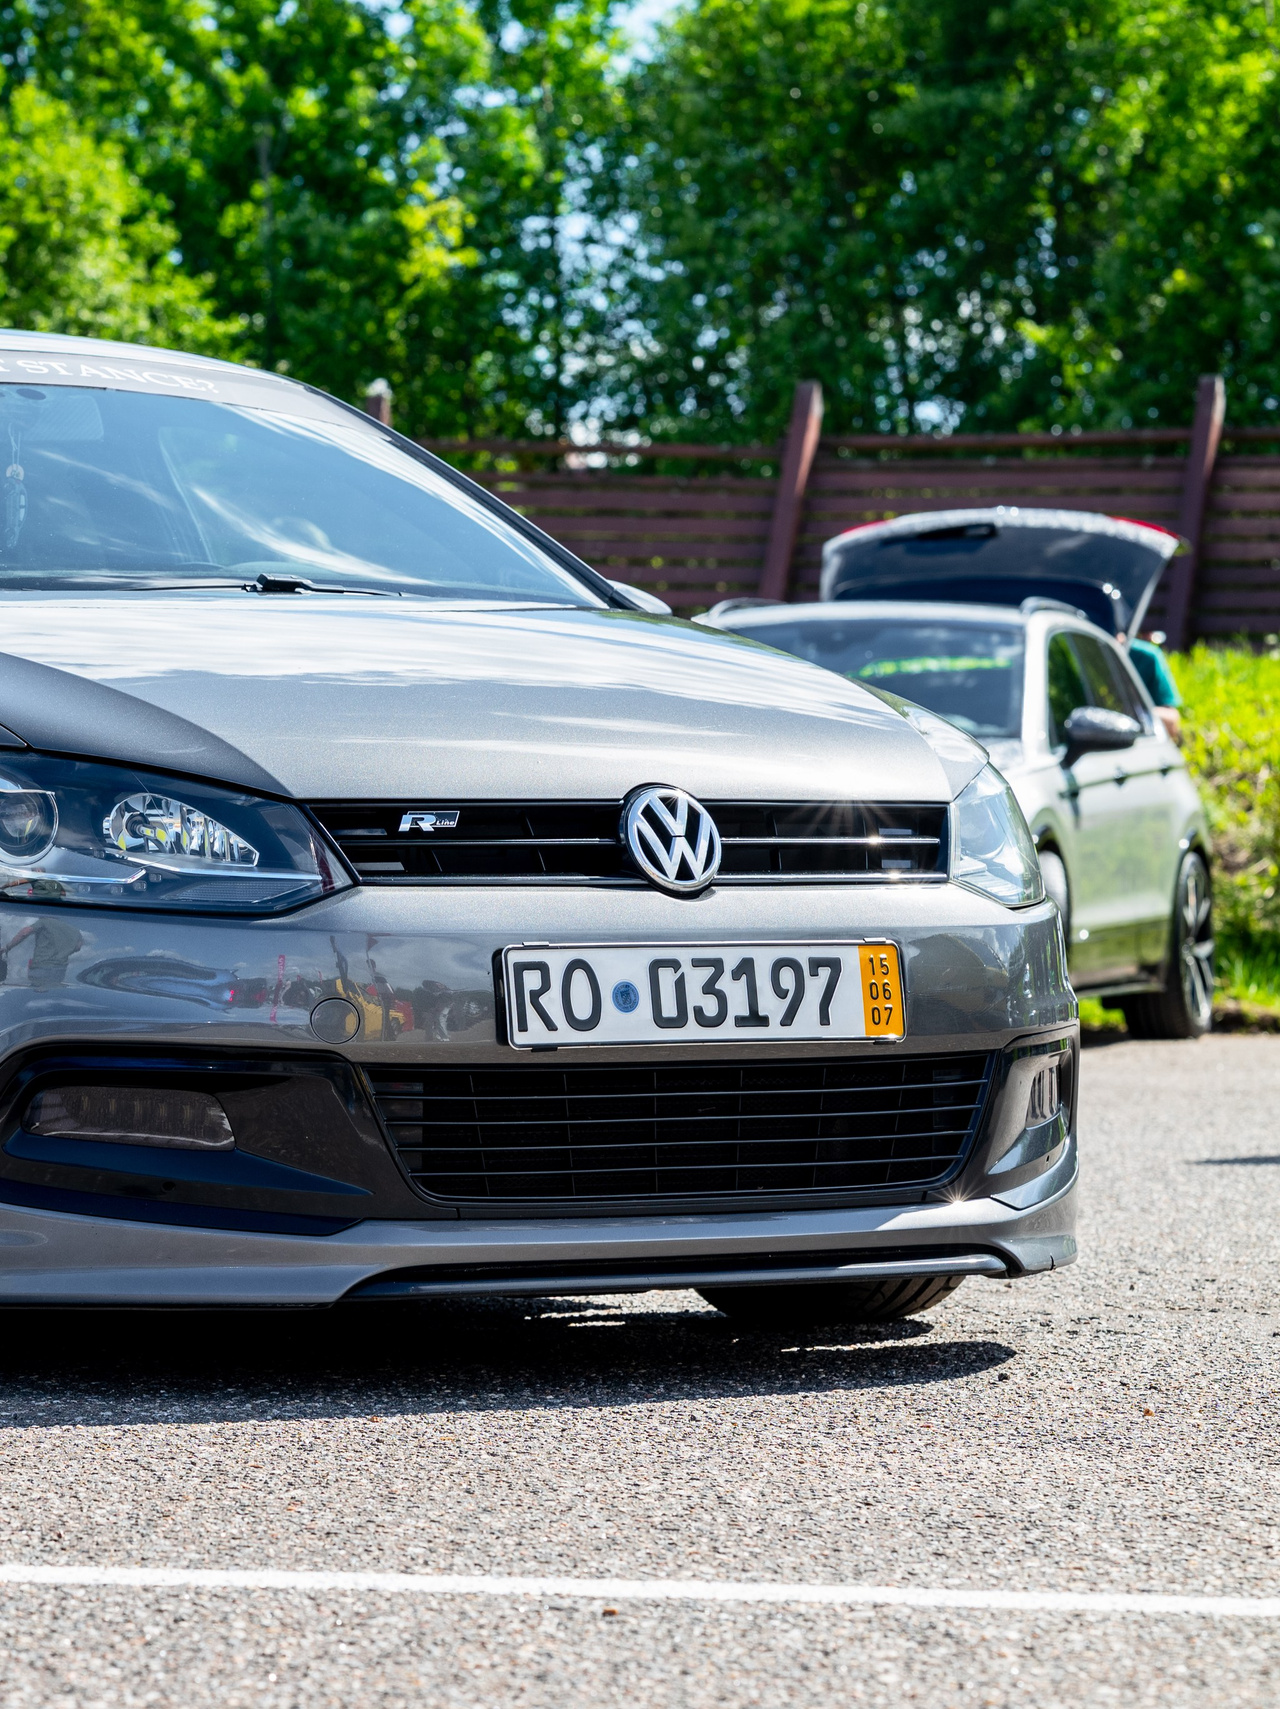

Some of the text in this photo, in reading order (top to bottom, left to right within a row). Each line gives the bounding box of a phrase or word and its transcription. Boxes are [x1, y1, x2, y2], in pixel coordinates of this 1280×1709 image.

[16, 359, 220, 394] STANCE?
[868, 954, 891, 977] 15
[512, 957, 603, 1032] RO
[648, 956, 843, 1030] 03197
[869, 979, 893, 1002] 06
[871, 1005, 894, 1027] 07
